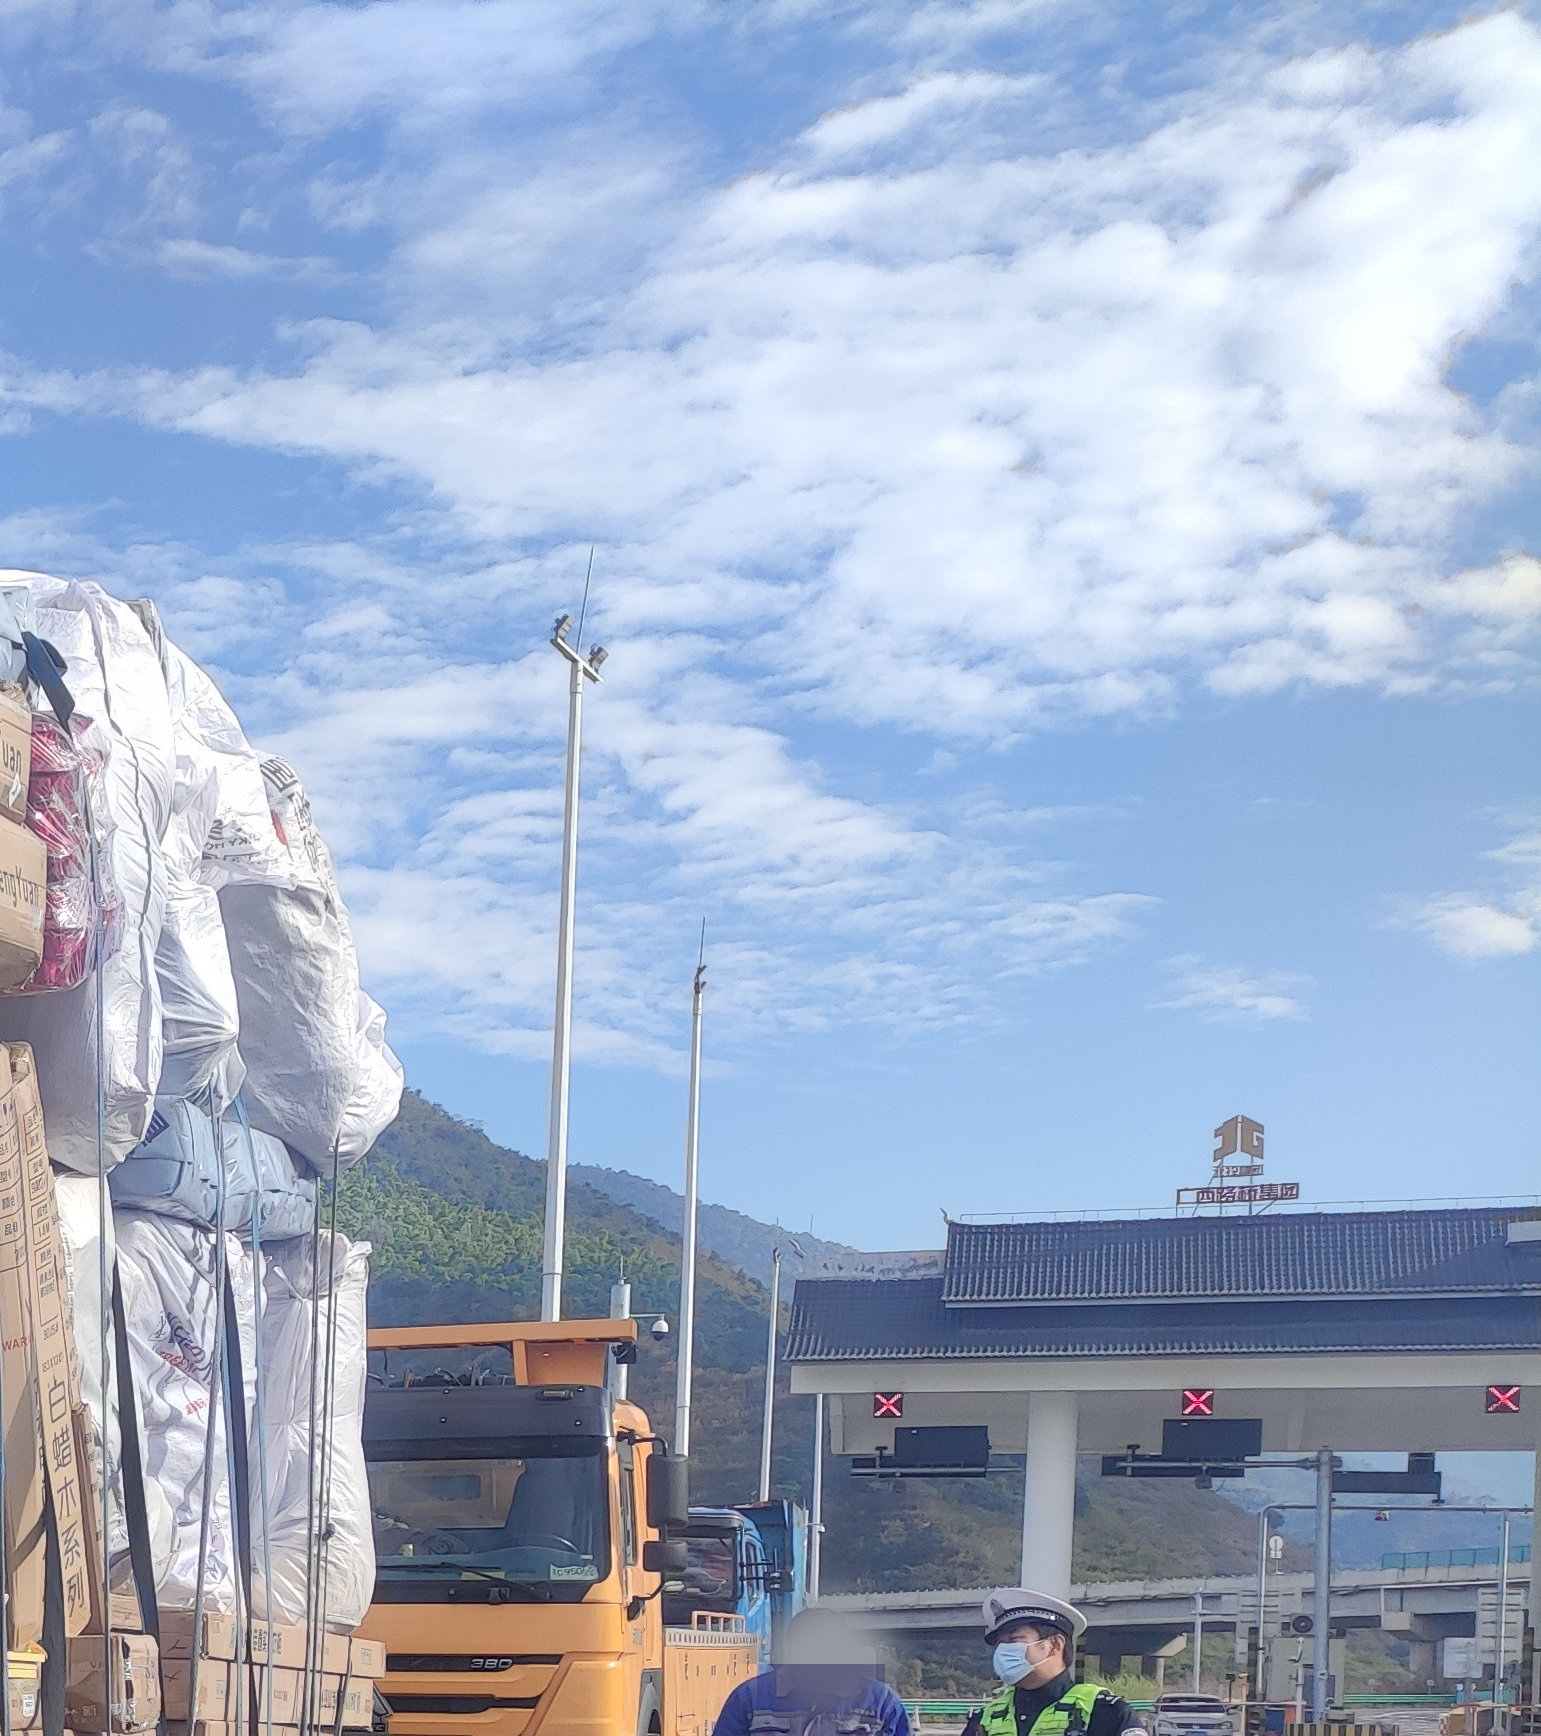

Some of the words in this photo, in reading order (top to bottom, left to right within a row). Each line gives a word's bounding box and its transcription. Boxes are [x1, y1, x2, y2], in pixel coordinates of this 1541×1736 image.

[2, 1334, 31, 1352] WAR
[48, 1370, 85, 1618] 白蜡木系列
[470, 1657, 514, 1671] 380
